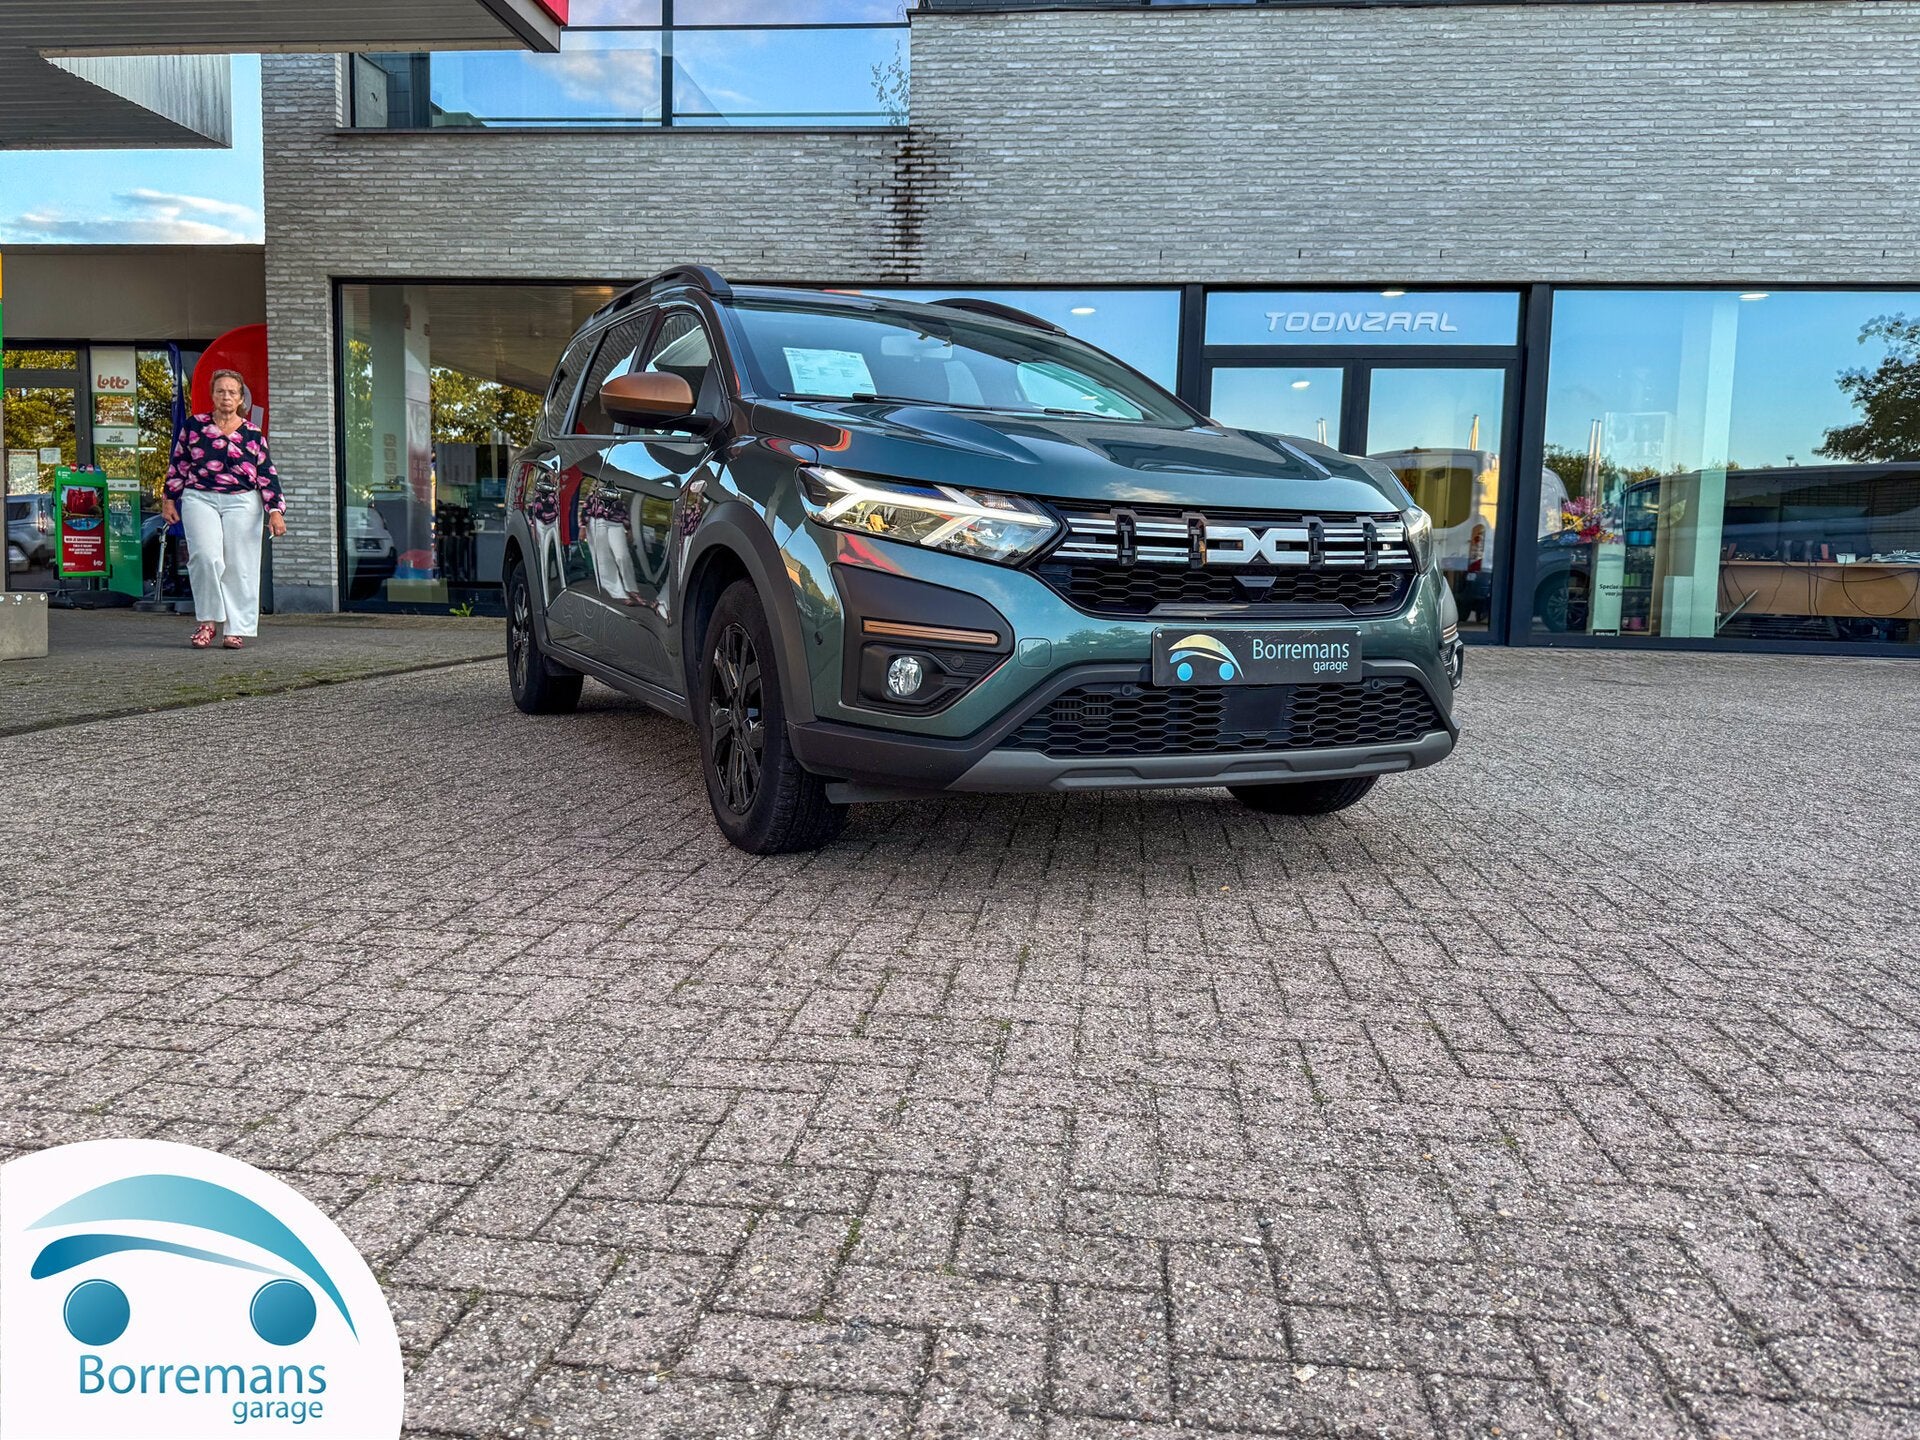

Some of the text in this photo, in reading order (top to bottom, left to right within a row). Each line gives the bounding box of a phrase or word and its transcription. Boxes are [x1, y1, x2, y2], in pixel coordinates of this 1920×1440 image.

[1265, 311, 1458, 332] TOONZAAL
[1253, 639, 1350, 659] Borremans
[1313, 661, 1348, 674] garage
